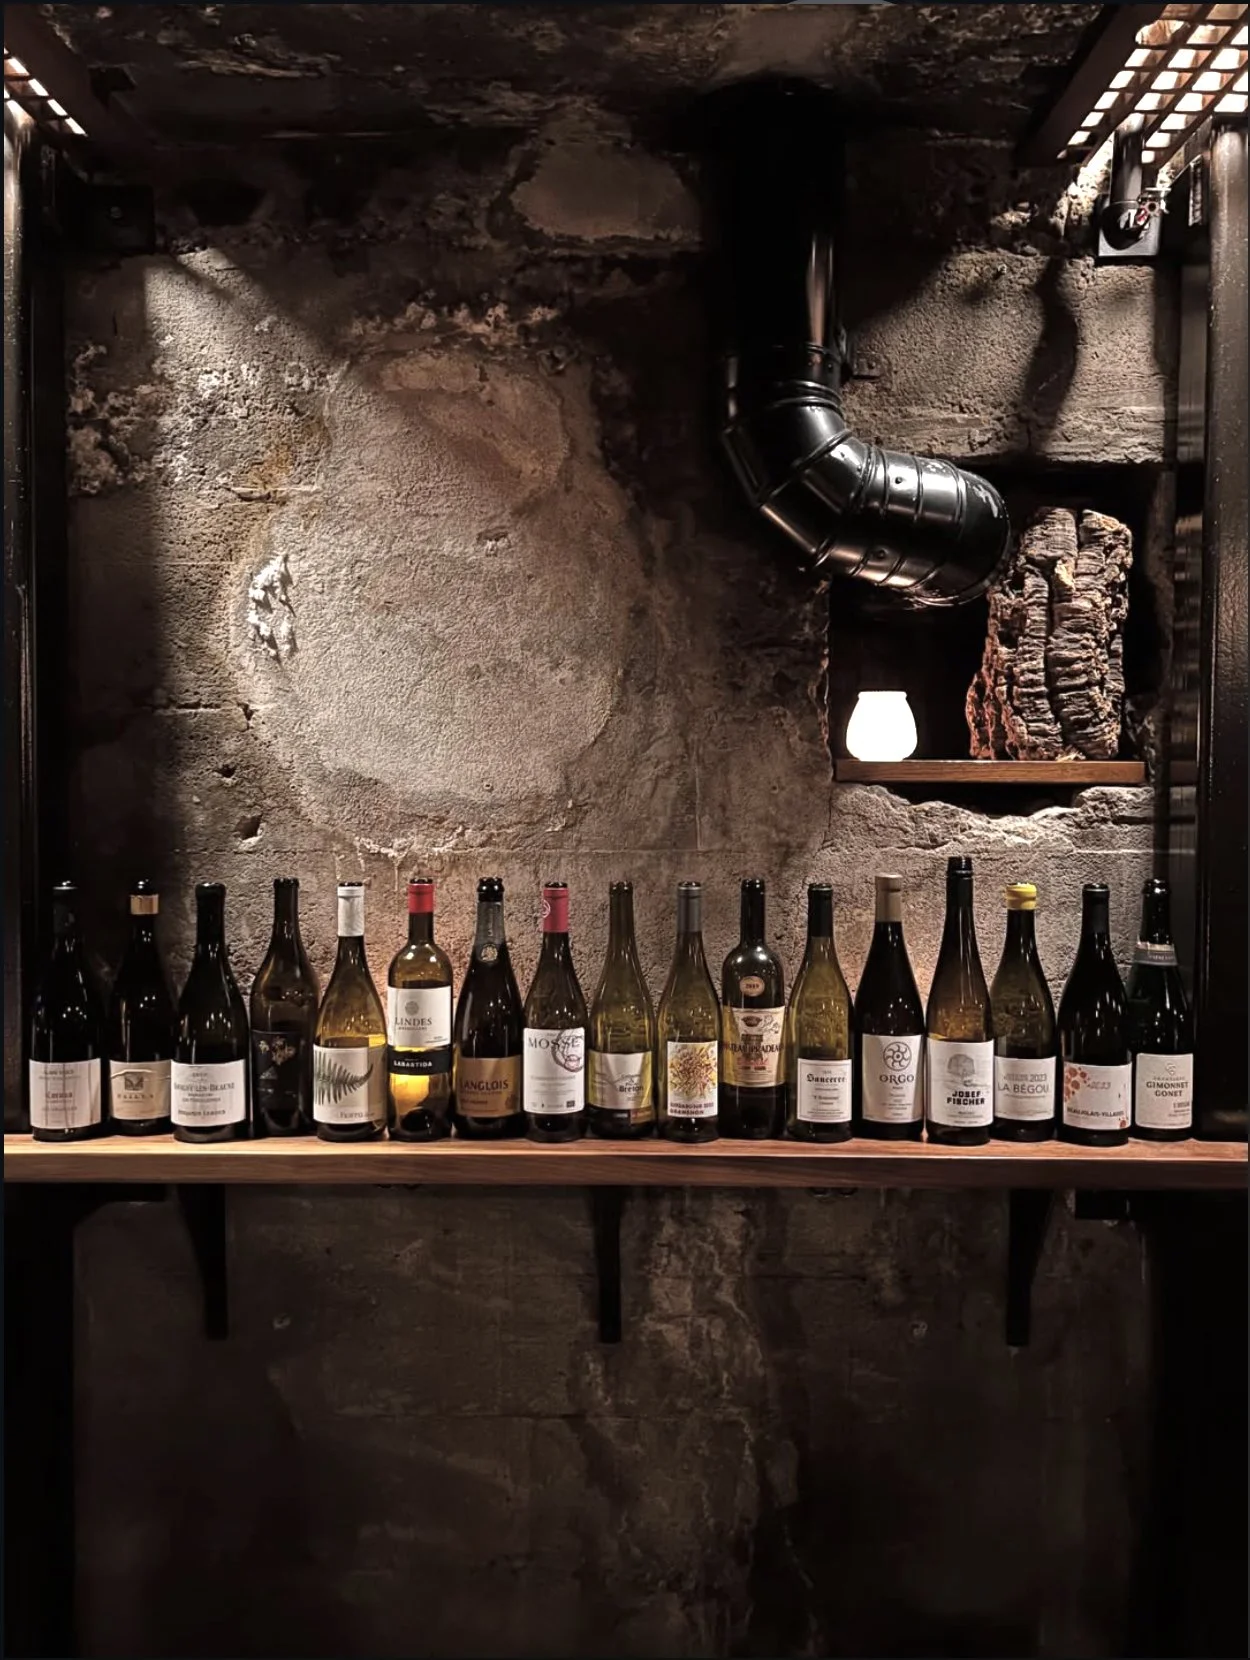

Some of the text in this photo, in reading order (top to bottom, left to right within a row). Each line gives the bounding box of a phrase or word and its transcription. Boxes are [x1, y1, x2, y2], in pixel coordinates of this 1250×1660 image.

[395, 1017, 433, 1027] LINDES
[879, 1074, 915, 1085] ORGO
[997, 1084, 1010, 1093] LA
[1155, 1089, 1183, 1097] GONET
[947, 1097, 985, 1106] FISCHER
